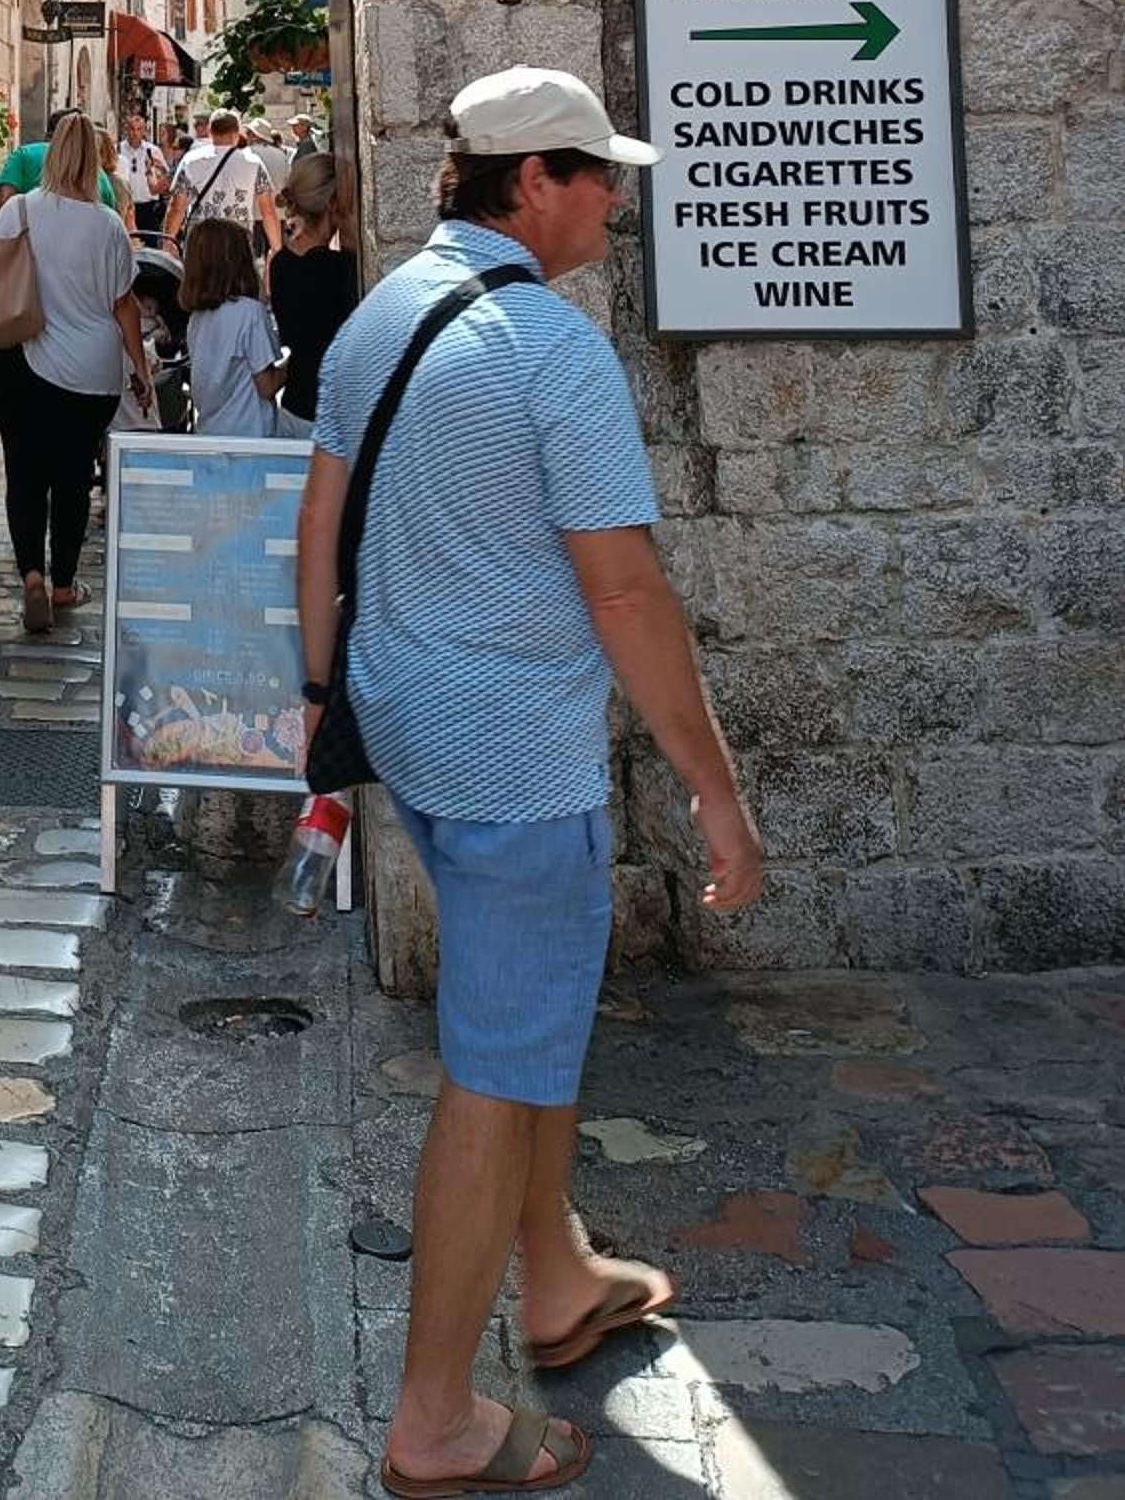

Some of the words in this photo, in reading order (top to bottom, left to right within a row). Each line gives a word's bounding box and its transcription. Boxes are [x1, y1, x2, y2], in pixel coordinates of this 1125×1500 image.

[669, 80, 772, 109] COLD
[783, 76, 925, 106] DRINKS
[673, 117, 924, 148] SANDWICHES
[687, 158, 914, 188] CIGARETTES
[674, 200, 790, 229] FRESH
[803, 198, 931, 227] FRUITS
[699, 241, 758, 269] ICE
[771, 239, 907, 268] CREAM
[754, 280, 855, 309] WINE
